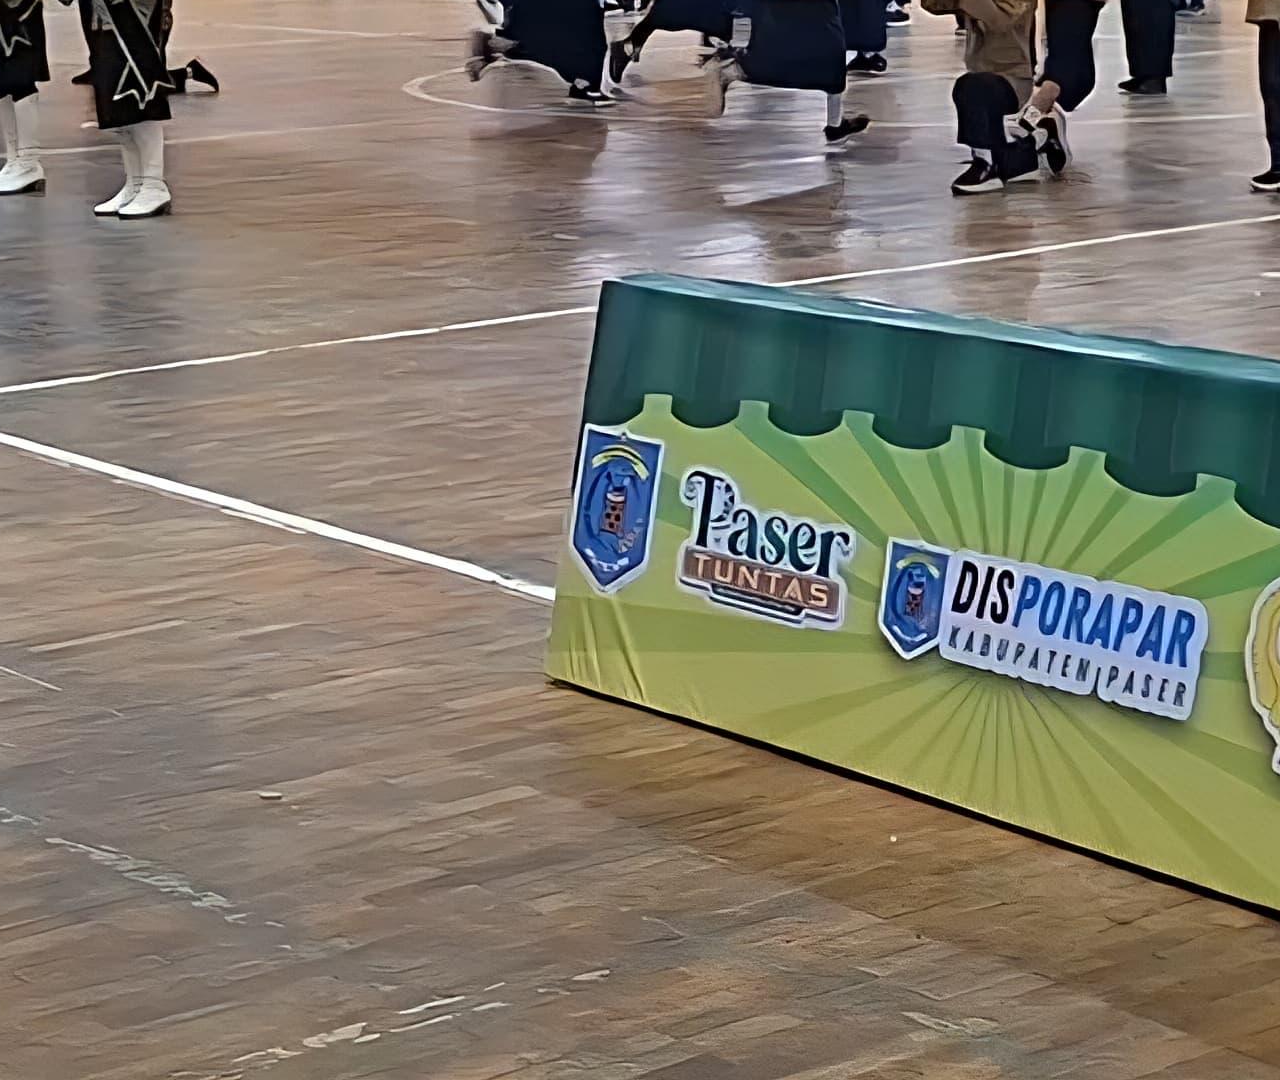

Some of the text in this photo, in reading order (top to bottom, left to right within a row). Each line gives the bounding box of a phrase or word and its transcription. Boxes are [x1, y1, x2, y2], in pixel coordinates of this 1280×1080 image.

[683, 469, 850, 580] Paser
[691, 551, 830, 609] TUNTAS
[950, 559, 1196, 668] DISPORAPAR
[948, 624, 1188, 707] KABUPATEN PASER
